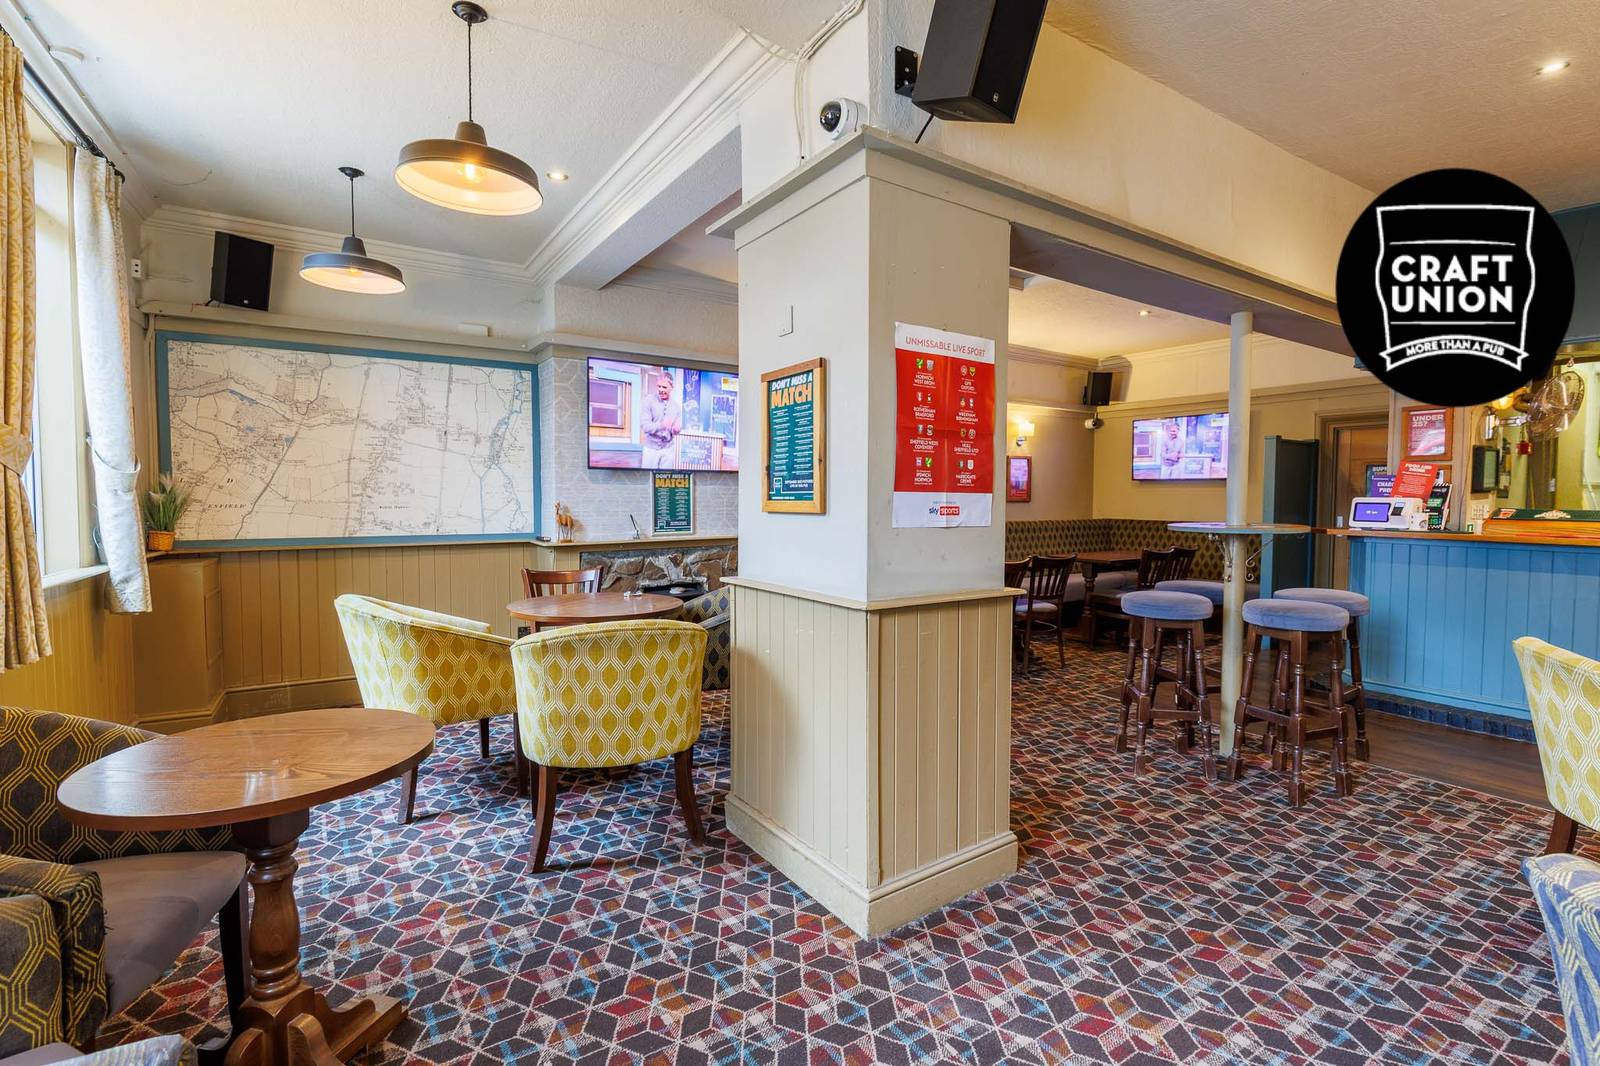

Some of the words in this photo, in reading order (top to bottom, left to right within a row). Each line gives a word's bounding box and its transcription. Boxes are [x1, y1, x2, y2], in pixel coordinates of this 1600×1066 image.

[905, 336, 952, 352] UNMISSABLE
[952, 344, 966, 354] LIVE
[967, 346, 986, 357] SPORT
[771, 382, 813, 408] MATCH
[655, 478, 689, 488] MATCH
[929, 506, 939, 515] sky
[940, 507, 959, 515] sports
